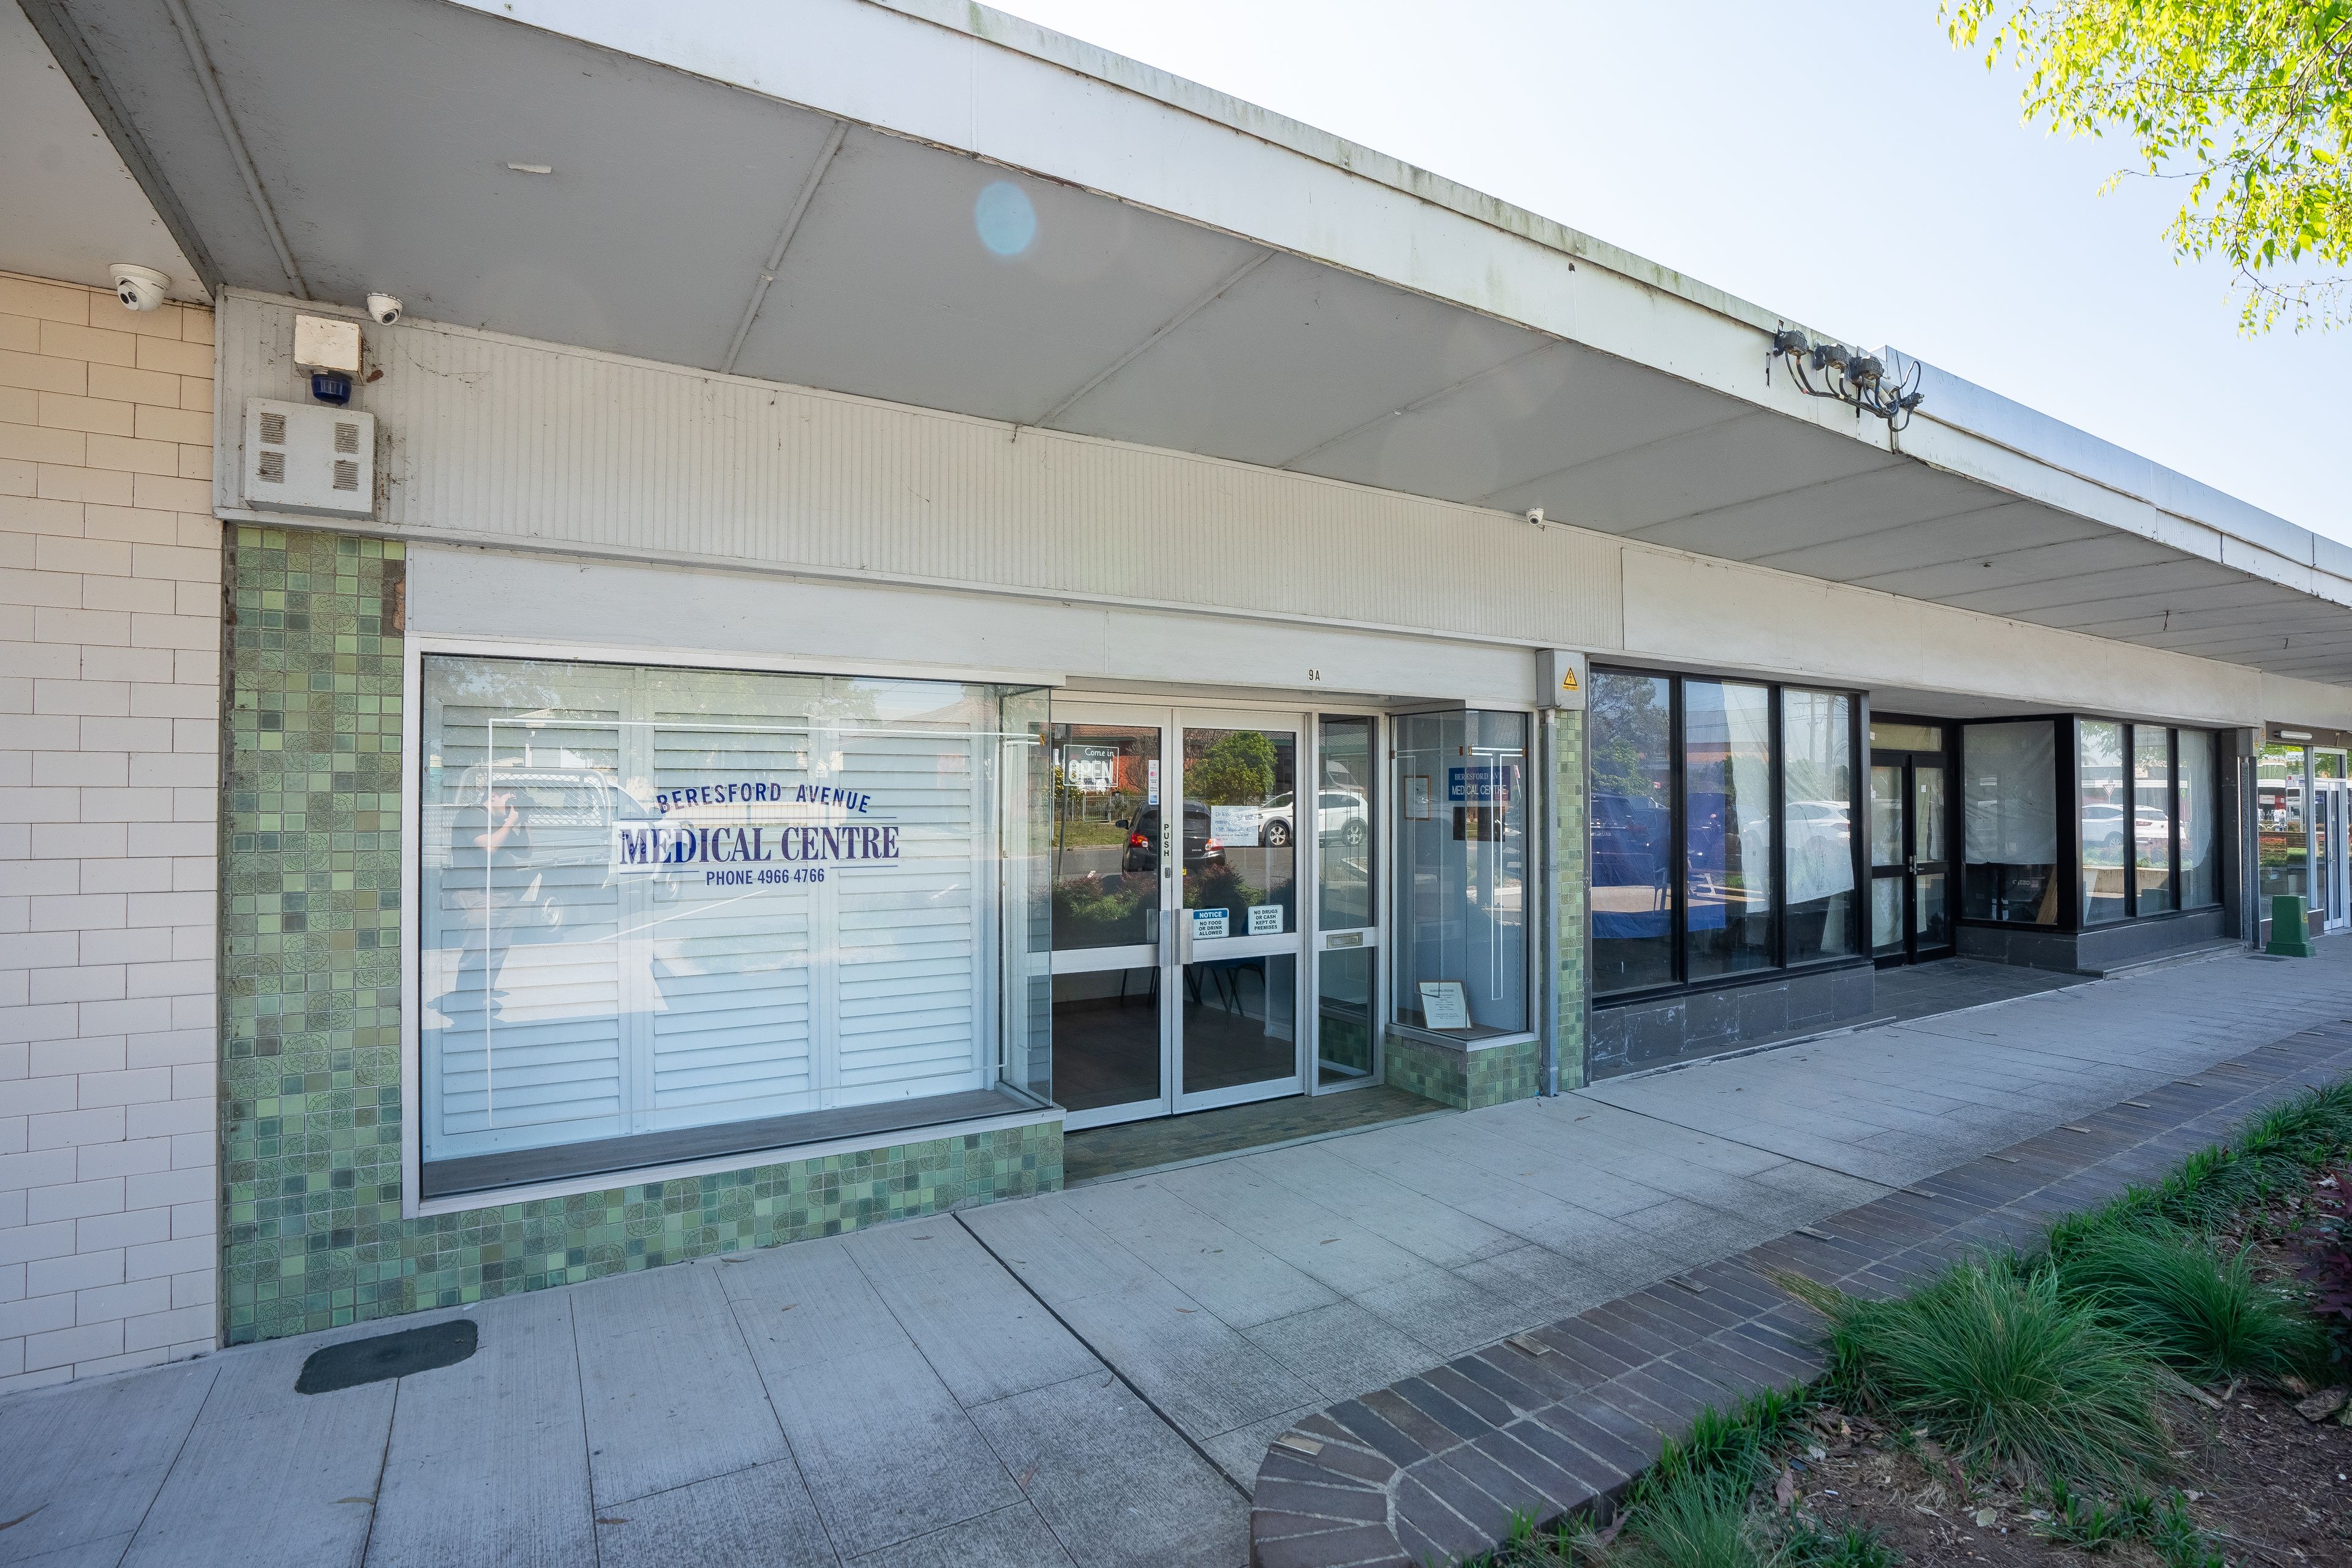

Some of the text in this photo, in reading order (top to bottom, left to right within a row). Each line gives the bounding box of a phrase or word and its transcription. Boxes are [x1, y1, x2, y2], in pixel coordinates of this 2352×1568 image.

[1308, 669, 1321, 681] 9A
[1084, 747, 1115, 757] Come in
[1068, 759, 1114, 783] OPEN
[1455, 772, 1488, 781] BERESFORD
[656, 783, 871, 814] BERESFORD AVENUE
[619, 826, 900, 864] MEDICAL CENTRE
[706, 868, 825, 886] PHONE 4966 4766
